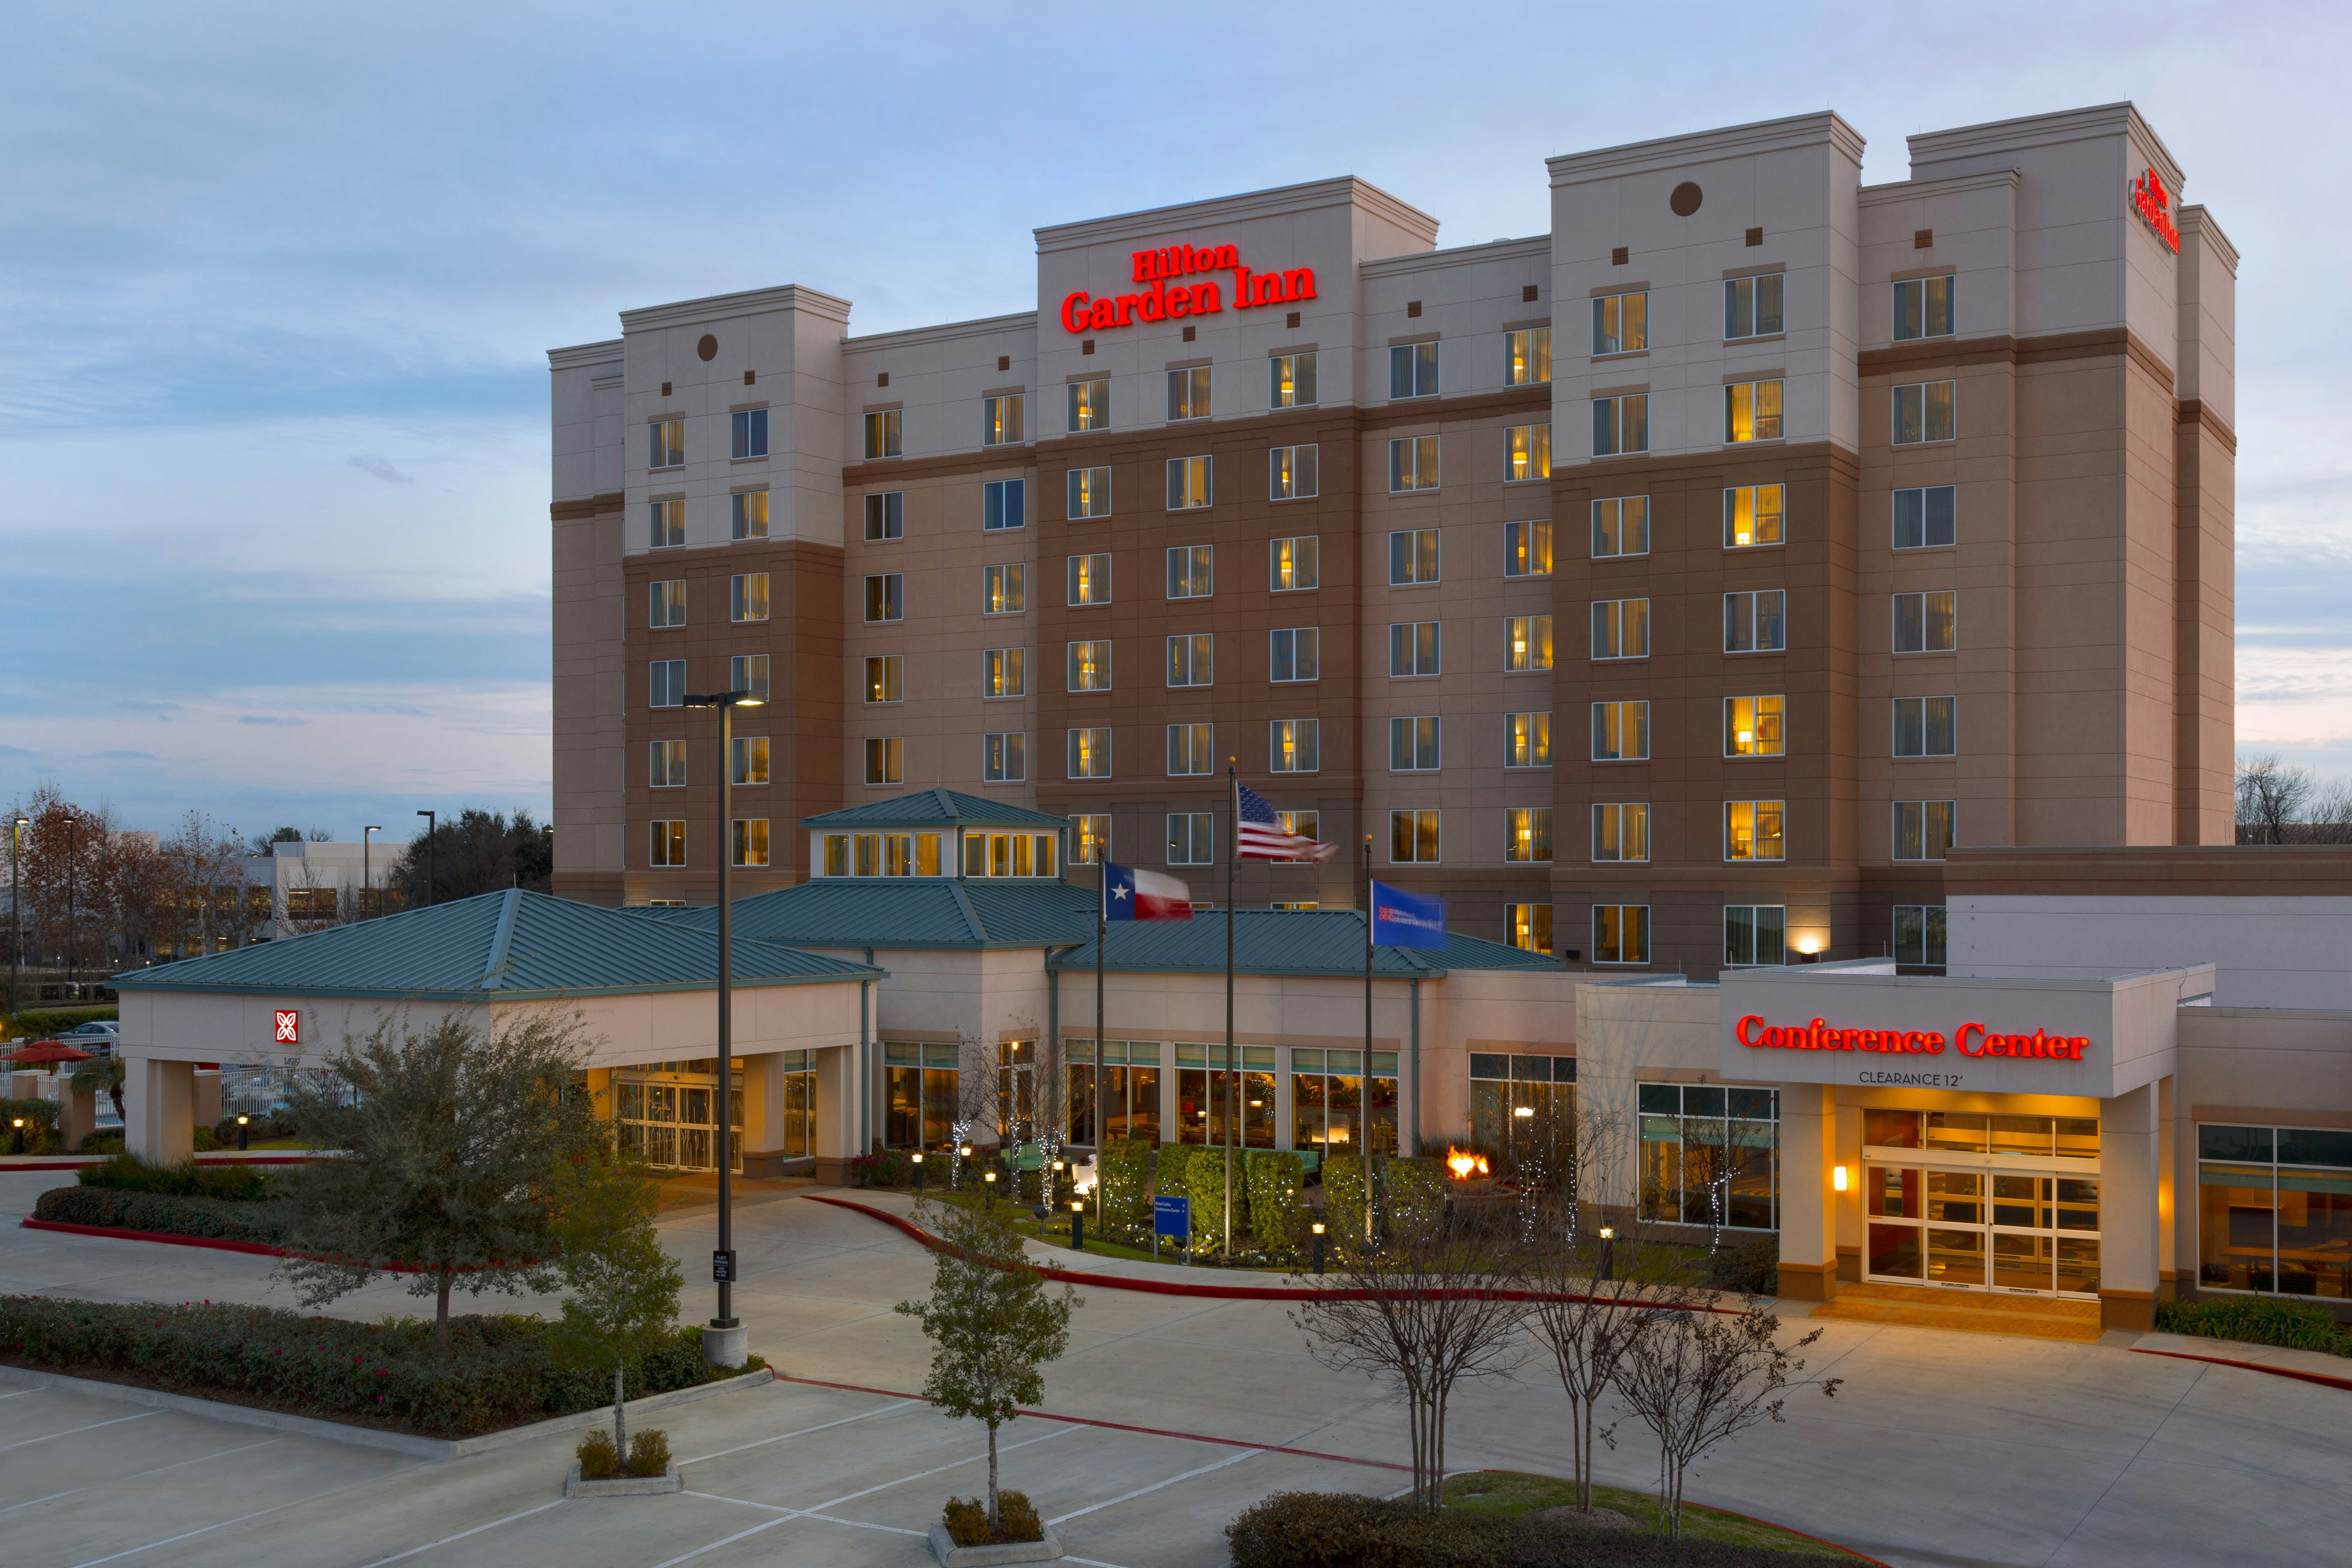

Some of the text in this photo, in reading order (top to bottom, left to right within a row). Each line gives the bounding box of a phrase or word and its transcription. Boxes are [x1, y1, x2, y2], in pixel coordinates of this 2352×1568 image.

[2136, 176, 2179, 255] Garden Inn
[1131, 244, 1239, 282] Hilton
[1061, 266, 1317, 332] Garden Inn
[1736, 1015, 2089, 1060] Conference Center
[284, 1057, 301, 1066] 14919
[1859, 1071, 1941, 1086] CLEARANCE
